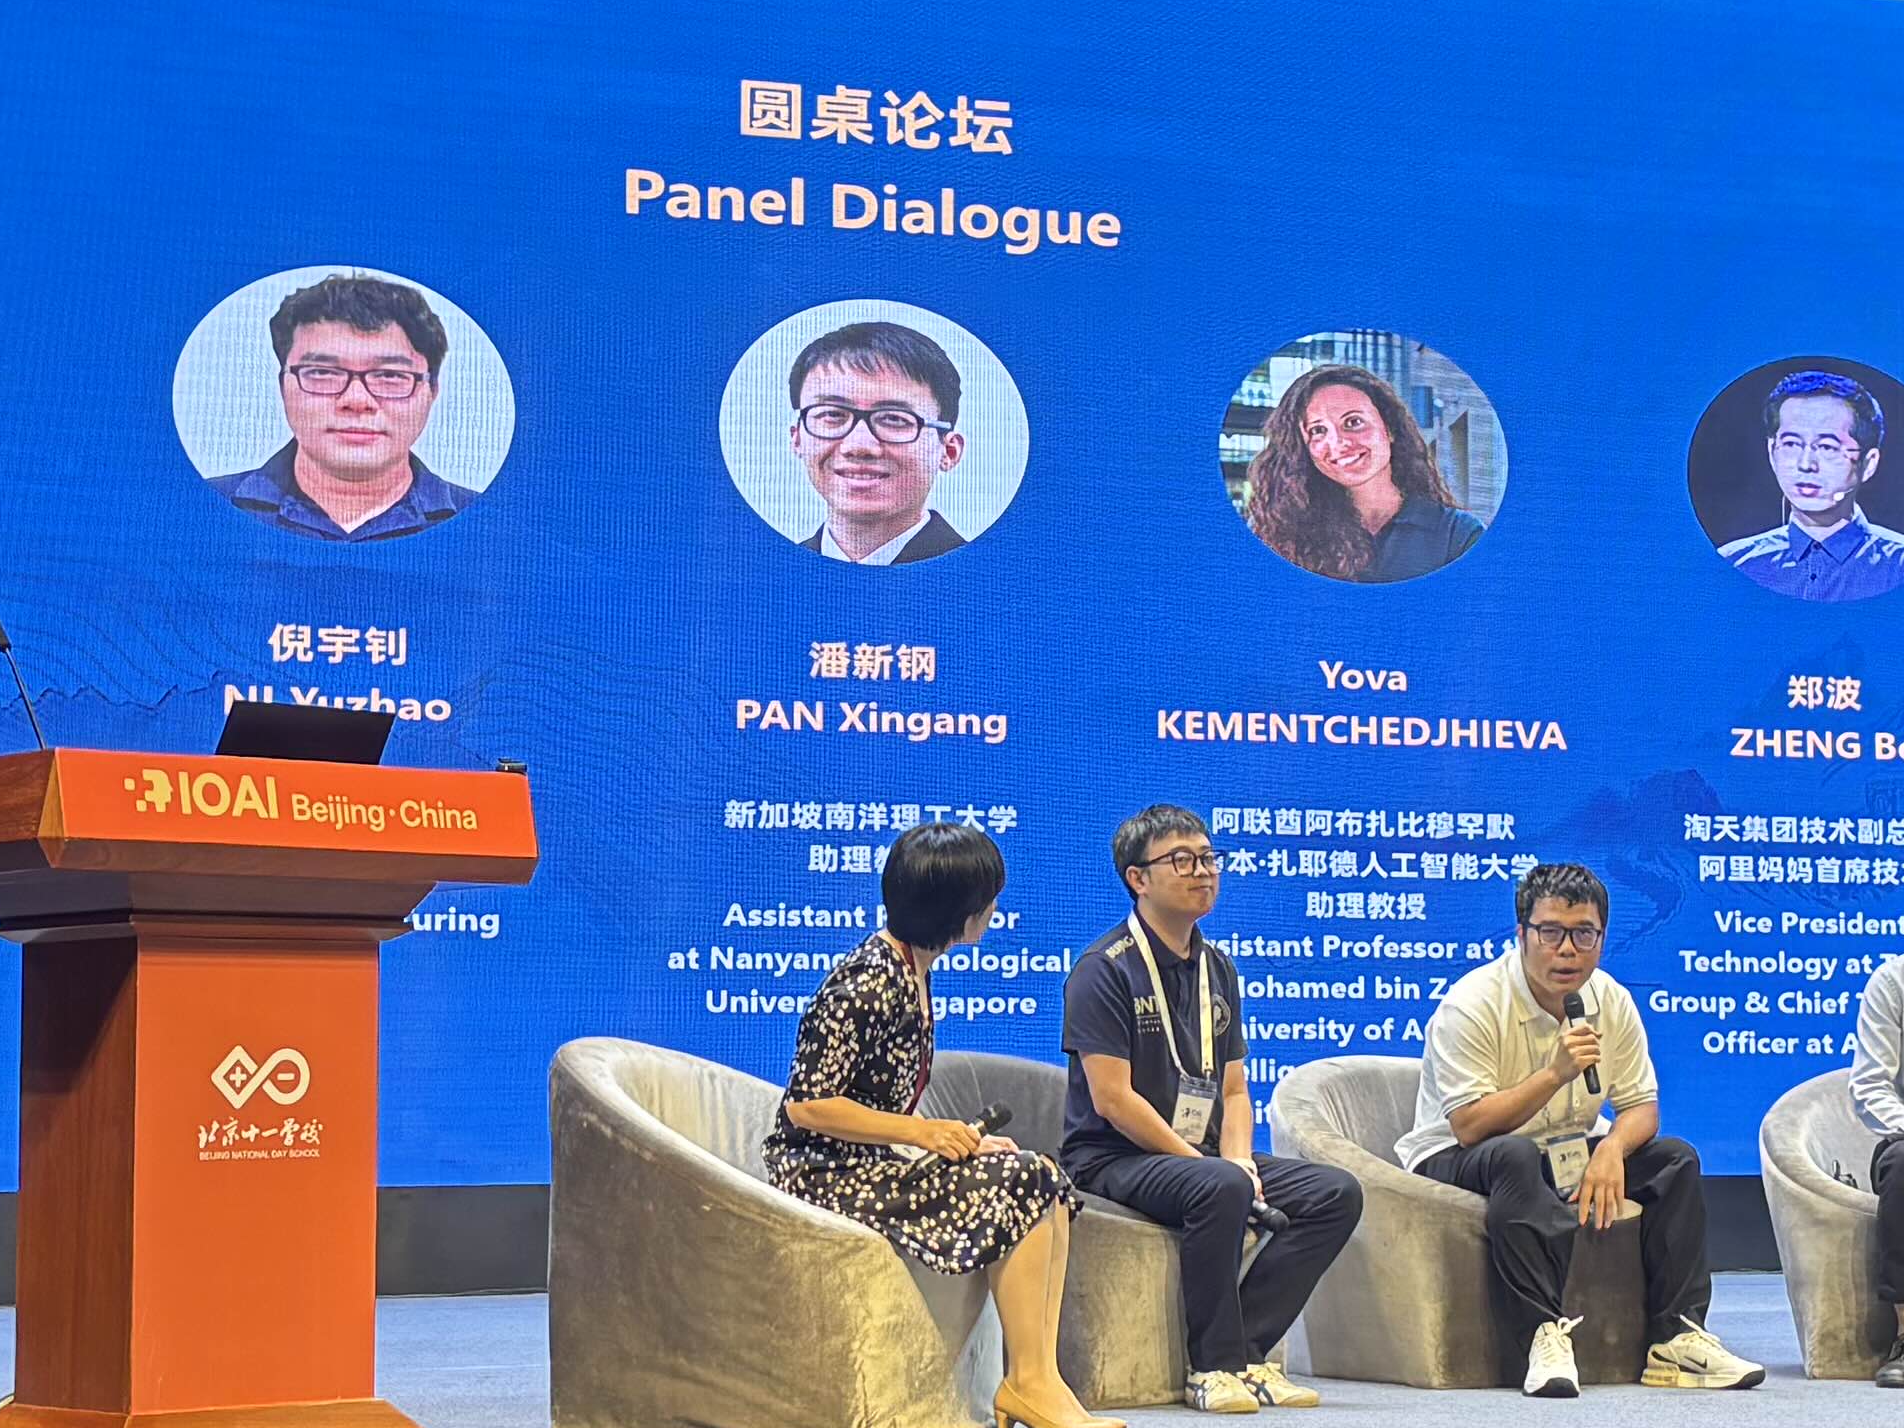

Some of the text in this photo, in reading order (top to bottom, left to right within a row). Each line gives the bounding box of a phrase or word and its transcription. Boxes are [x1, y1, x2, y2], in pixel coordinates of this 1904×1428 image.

[741, 79, 1013, 155] 圆桌论坛
[625, 168, 1121, 255] Panel Dialogue
[268, 623, 408, 666] 倪宇钊
[808, 641, 936, 683] 潘新钢
[1318, 660, 1408, 692] Yova
[1787, 675, 1862, 712] 郑波
[736, 699, 1008, 744] PAN Xingang
[1156, 709, 1568, 751] KEMENTCHEDJHIEVA
[1729, 727, 1862, 760] ZHENG
[178, 771, 280, 821] IOAI
[722, 901, 866, 929] Assistant
[1305, 891, 1427, 921] 助理教授
[1714, 910, 1771, 934] Vice
[667, 950, 700, 971] at
[1322, 934, 1456, 959] Professor
[1465, 938, 1495, 960] at
[1679, 949, 1838, 981] Technology
[1845, 954, 1873, 974] at
[1374, 975, 1421, 1000] bin
[1649, 989, 1850, 1020] Group & Chief
[1363, 1018, 1395, 1041] of
[1702, 1031, 1798, 1054] Officer
[1806, 1035, 1834, 1055] at
